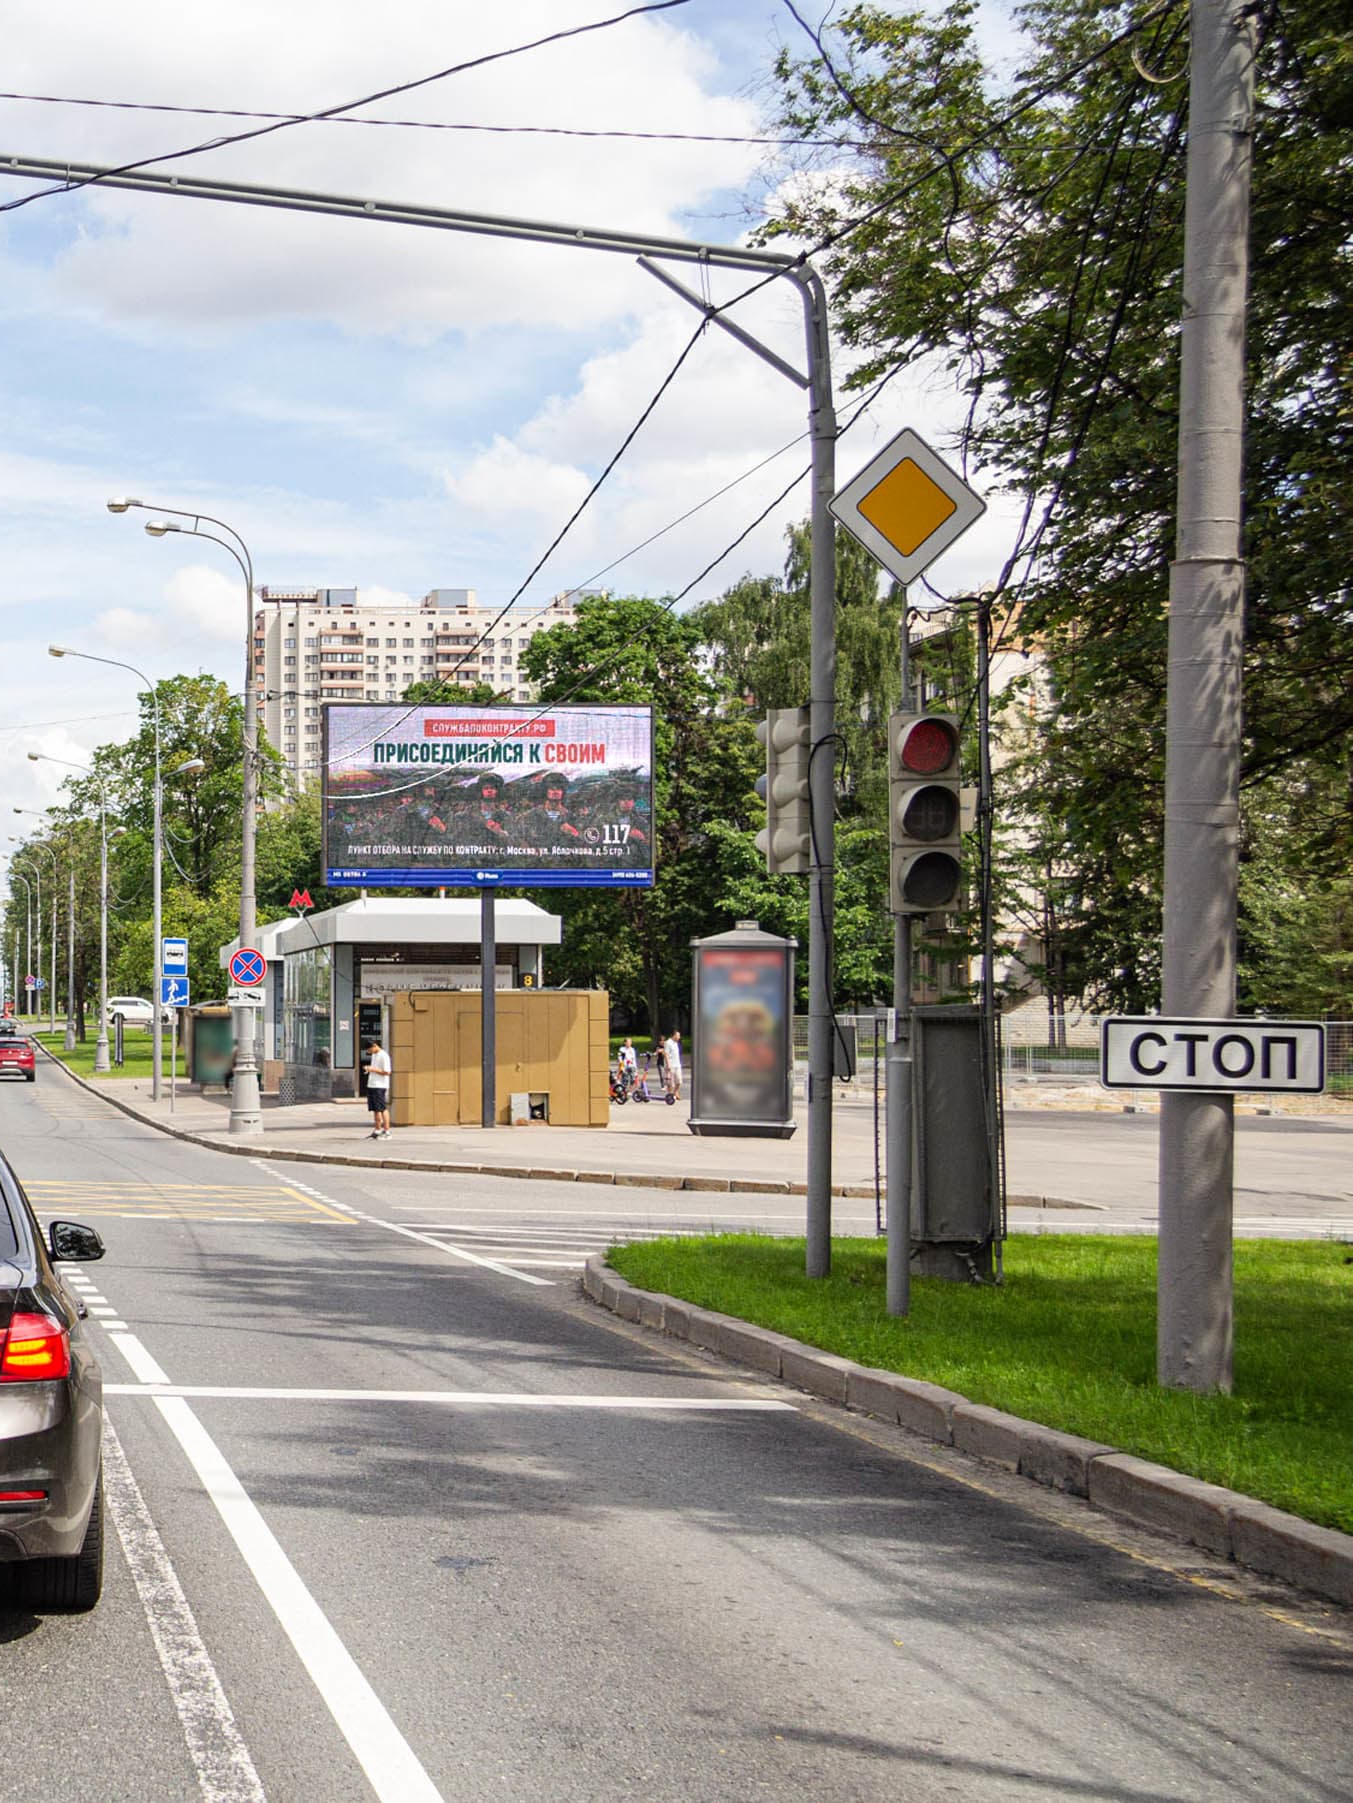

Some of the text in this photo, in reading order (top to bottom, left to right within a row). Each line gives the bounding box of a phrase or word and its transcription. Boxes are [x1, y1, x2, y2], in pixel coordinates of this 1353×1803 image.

[374, 742, 605, 765] ПРИСОЕДИНЯЙСЯ К СВОИМ
[602, 824, 631, 844] 117
[524, 975, 533, 987] 8
[1129, 1031, 1297, 1080] СТОП
